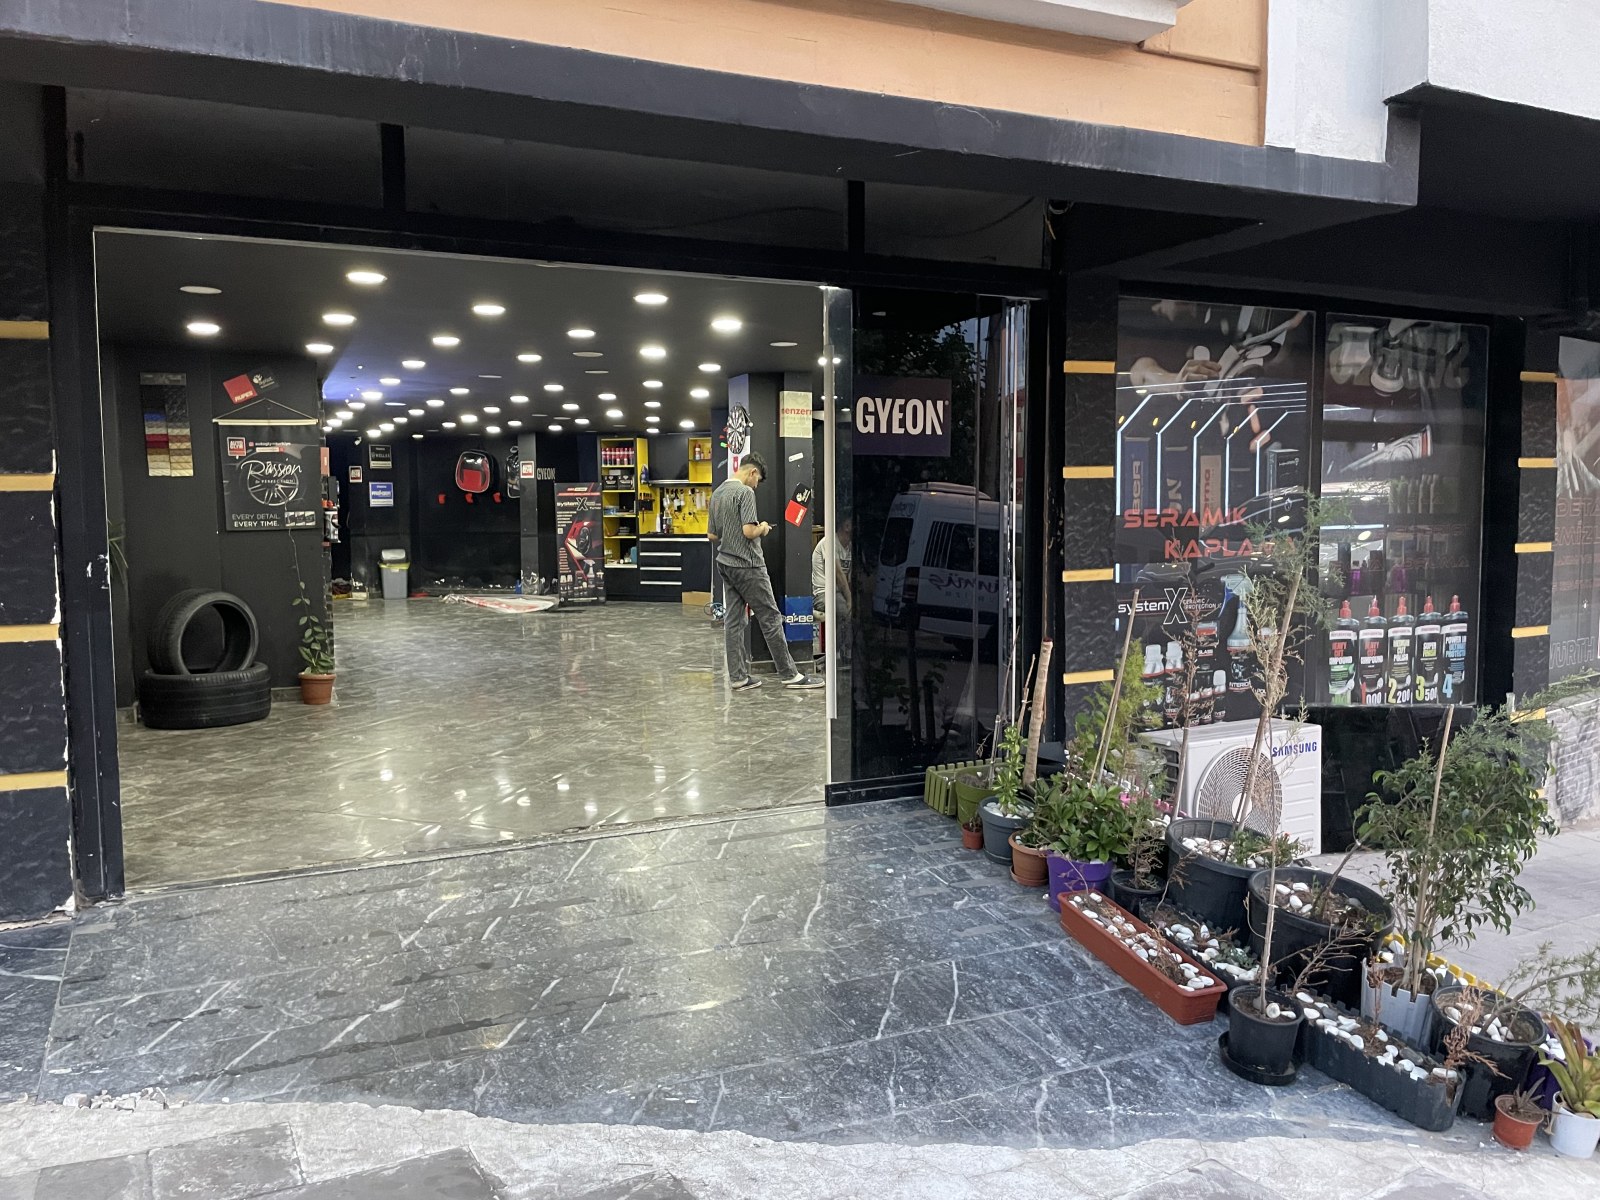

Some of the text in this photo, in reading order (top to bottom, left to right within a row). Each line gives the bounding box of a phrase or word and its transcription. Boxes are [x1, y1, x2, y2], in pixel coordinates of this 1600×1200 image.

[856, 396, 944, 436] GYEON
[240, 457, 302, 478] Passion
[536, 467, 556, 480] GYEON
[234, 520, 258, 528] EVERY
[1442, 673, 1453, 698] 4
[1271, 741, 1317, 757] SAMSUNG
